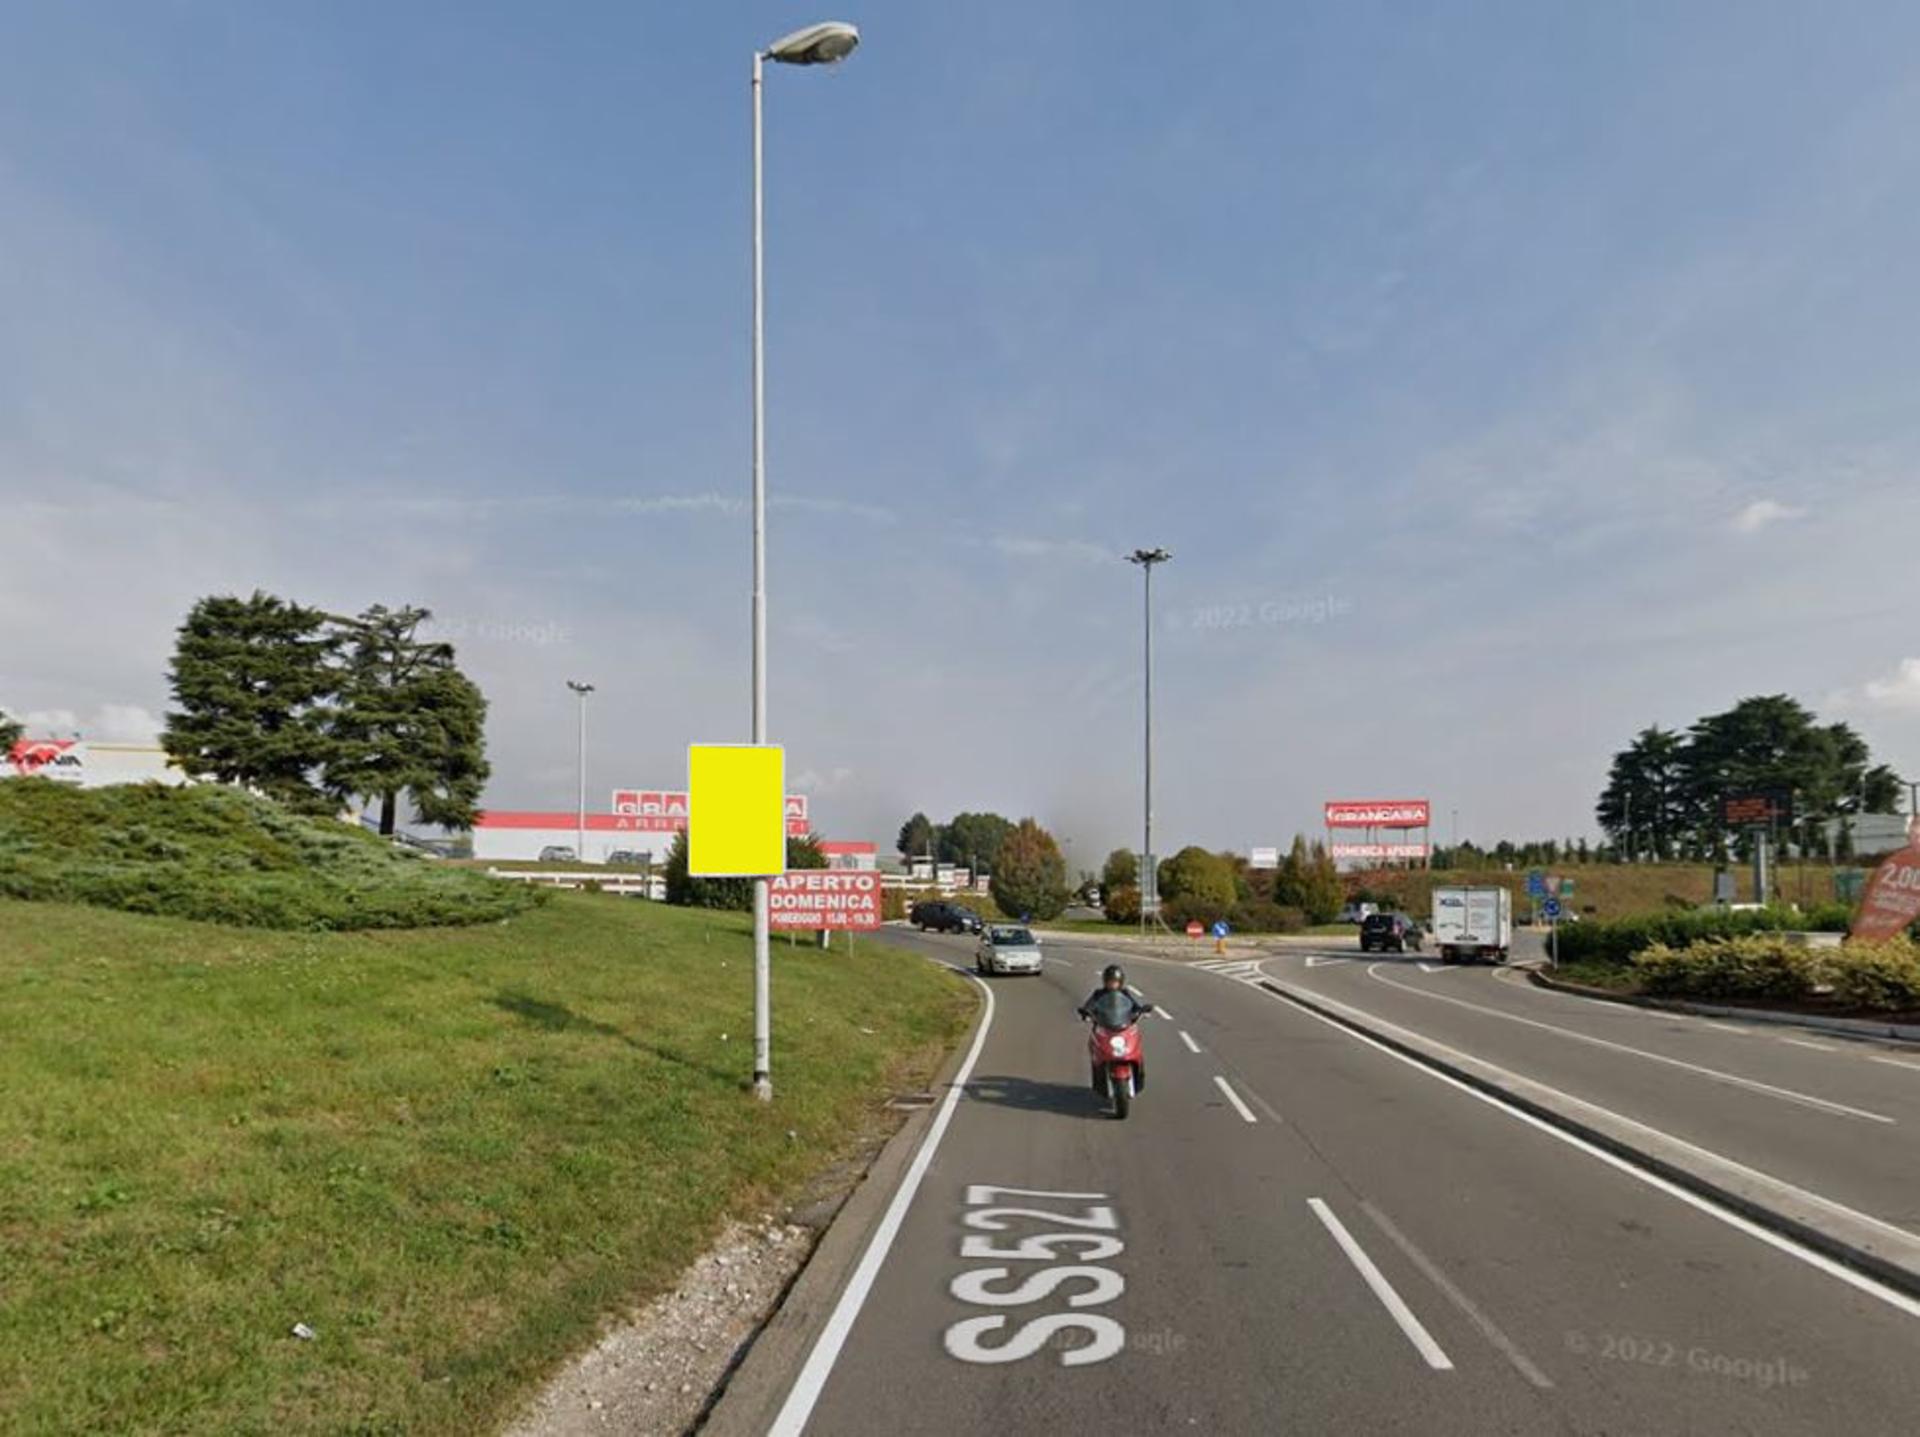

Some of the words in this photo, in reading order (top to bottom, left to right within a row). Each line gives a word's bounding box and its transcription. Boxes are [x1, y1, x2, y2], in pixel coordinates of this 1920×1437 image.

[772, 875, 875, 891] APERTO
[770, 893, 875, 910] DOMENICA
[945, 1185, 1124, 1366] SS527
